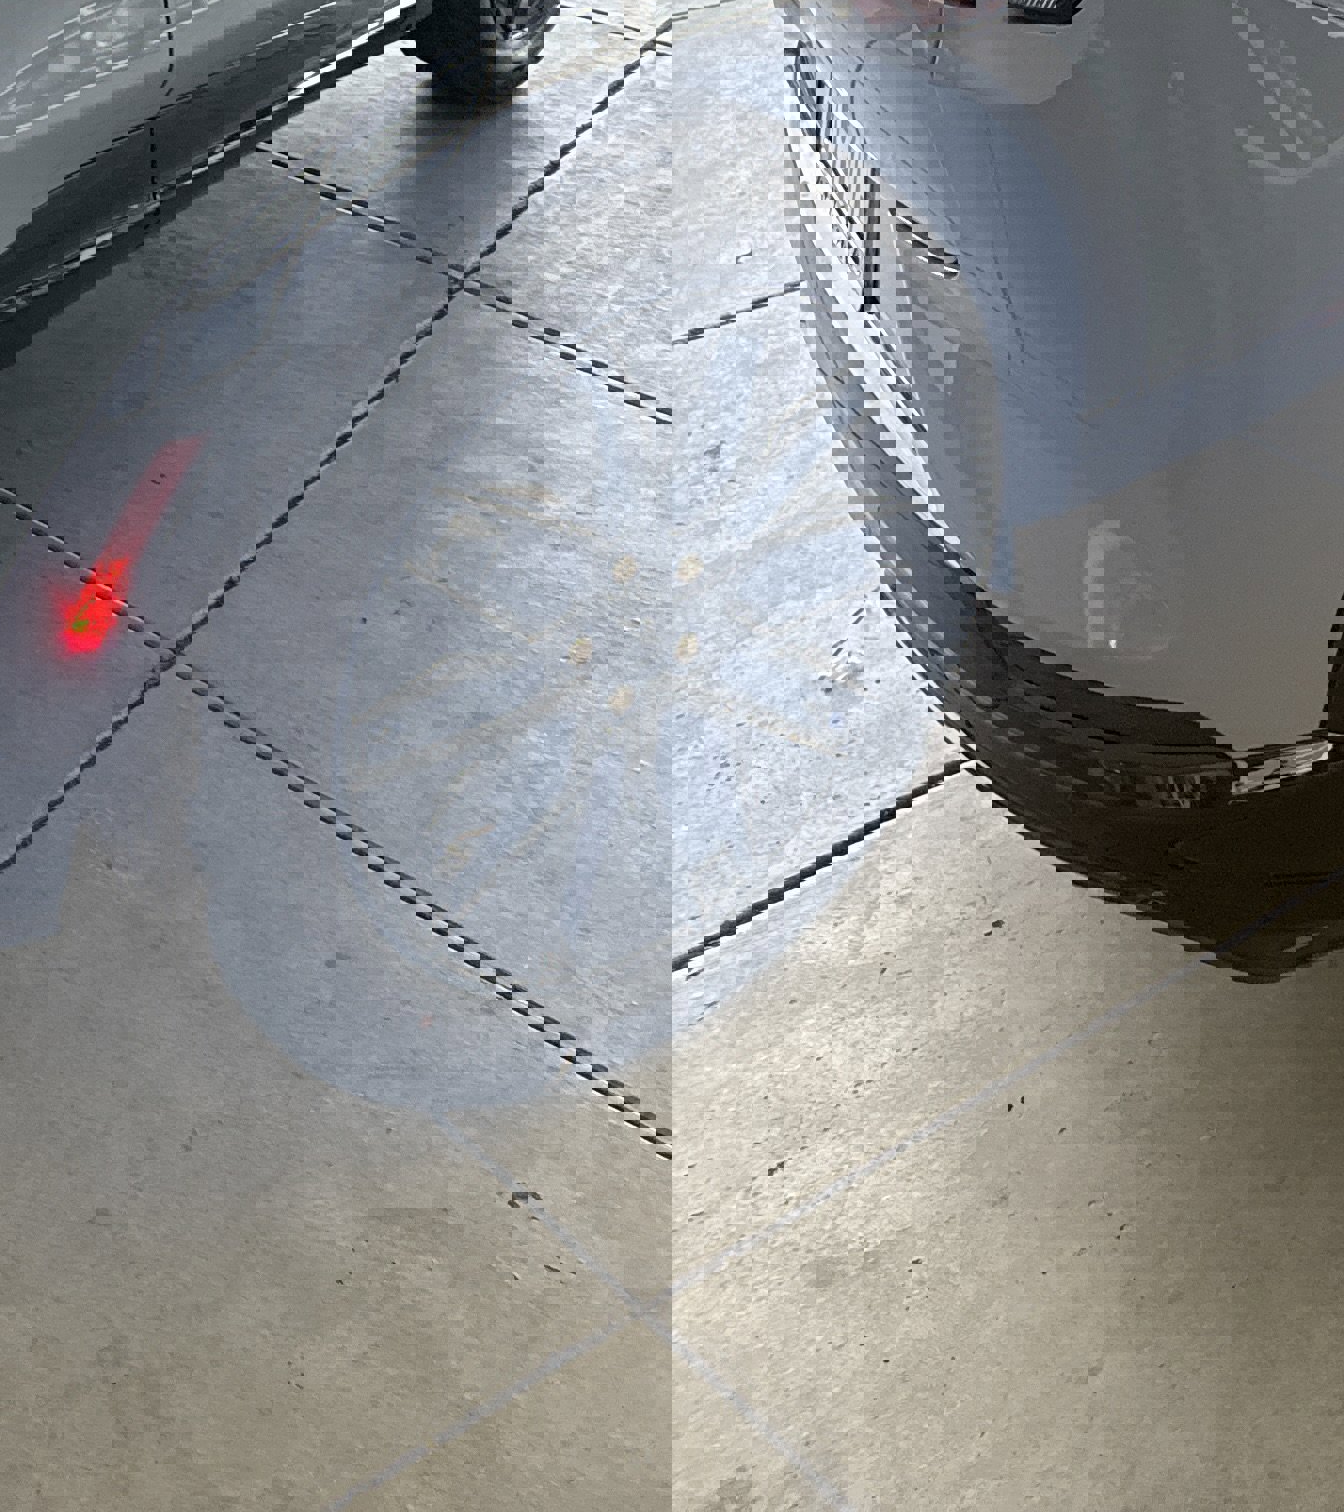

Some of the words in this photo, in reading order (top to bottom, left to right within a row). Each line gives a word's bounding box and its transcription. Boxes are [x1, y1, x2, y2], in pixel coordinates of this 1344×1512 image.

[599, 184, 816, 261] ALENZA
[253, 506, 368, 970] BRIDGESTONE
[908, 366, 995, 750] BRIDGESTONE
